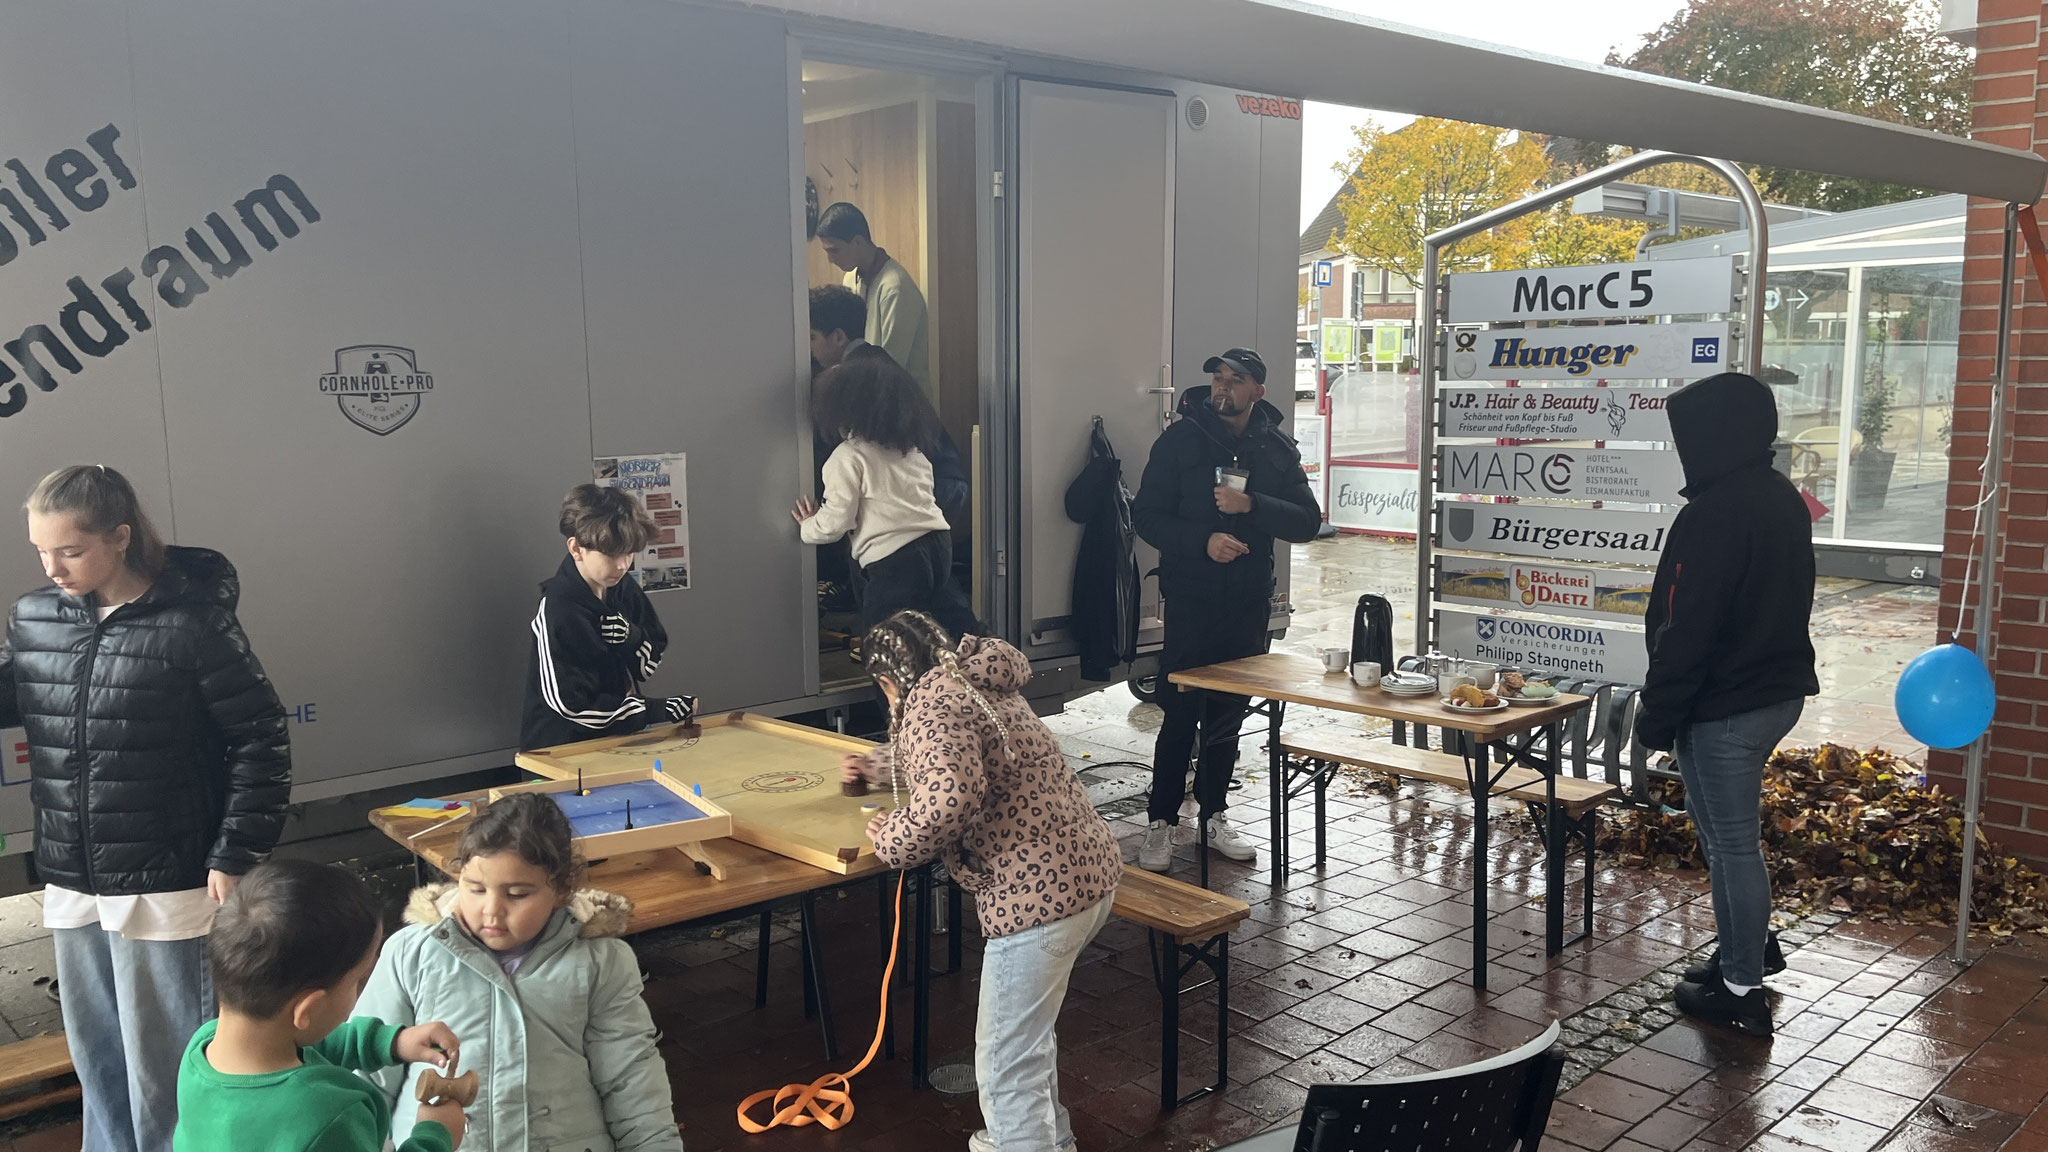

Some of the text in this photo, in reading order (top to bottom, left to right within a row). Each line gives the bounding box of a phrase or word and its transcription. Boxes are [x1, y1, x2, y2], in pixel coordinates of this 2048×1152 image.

[1235, 93, 1301, 120] vezeko
[0, 122, 136, 266] iler
[1488, 336, 1639, 376] Hunger
[1694, 344, 1716, 358] EG
[1449, 393, 1667, 414] J.P. Hair & Beauty Tea
[1463, 411, 1574, 423] Schönheit von Kopf bis Fuß
[1458, 423, 1578, 435] Friseur und Fußpflege-Studio
[1586, 465, 1629, 475] EVENTSAAL
[1585, 476, 1639, 486] BISTRORANTE
[1338, 483, 1419, 516] Eisspezialit
[1585, 486, 1651, 498] EISMANUFAKTUR
[1488, 516, 1665, 552] Bürgersaal
[1538, 586, 1588, 607] DAETZ
[1499, 620, 1606, 646] CONCORDIA
[1501, 635, 1605, 656] Versicherungen
[1476, 644, 1604, 674] Philipp Stangneth
